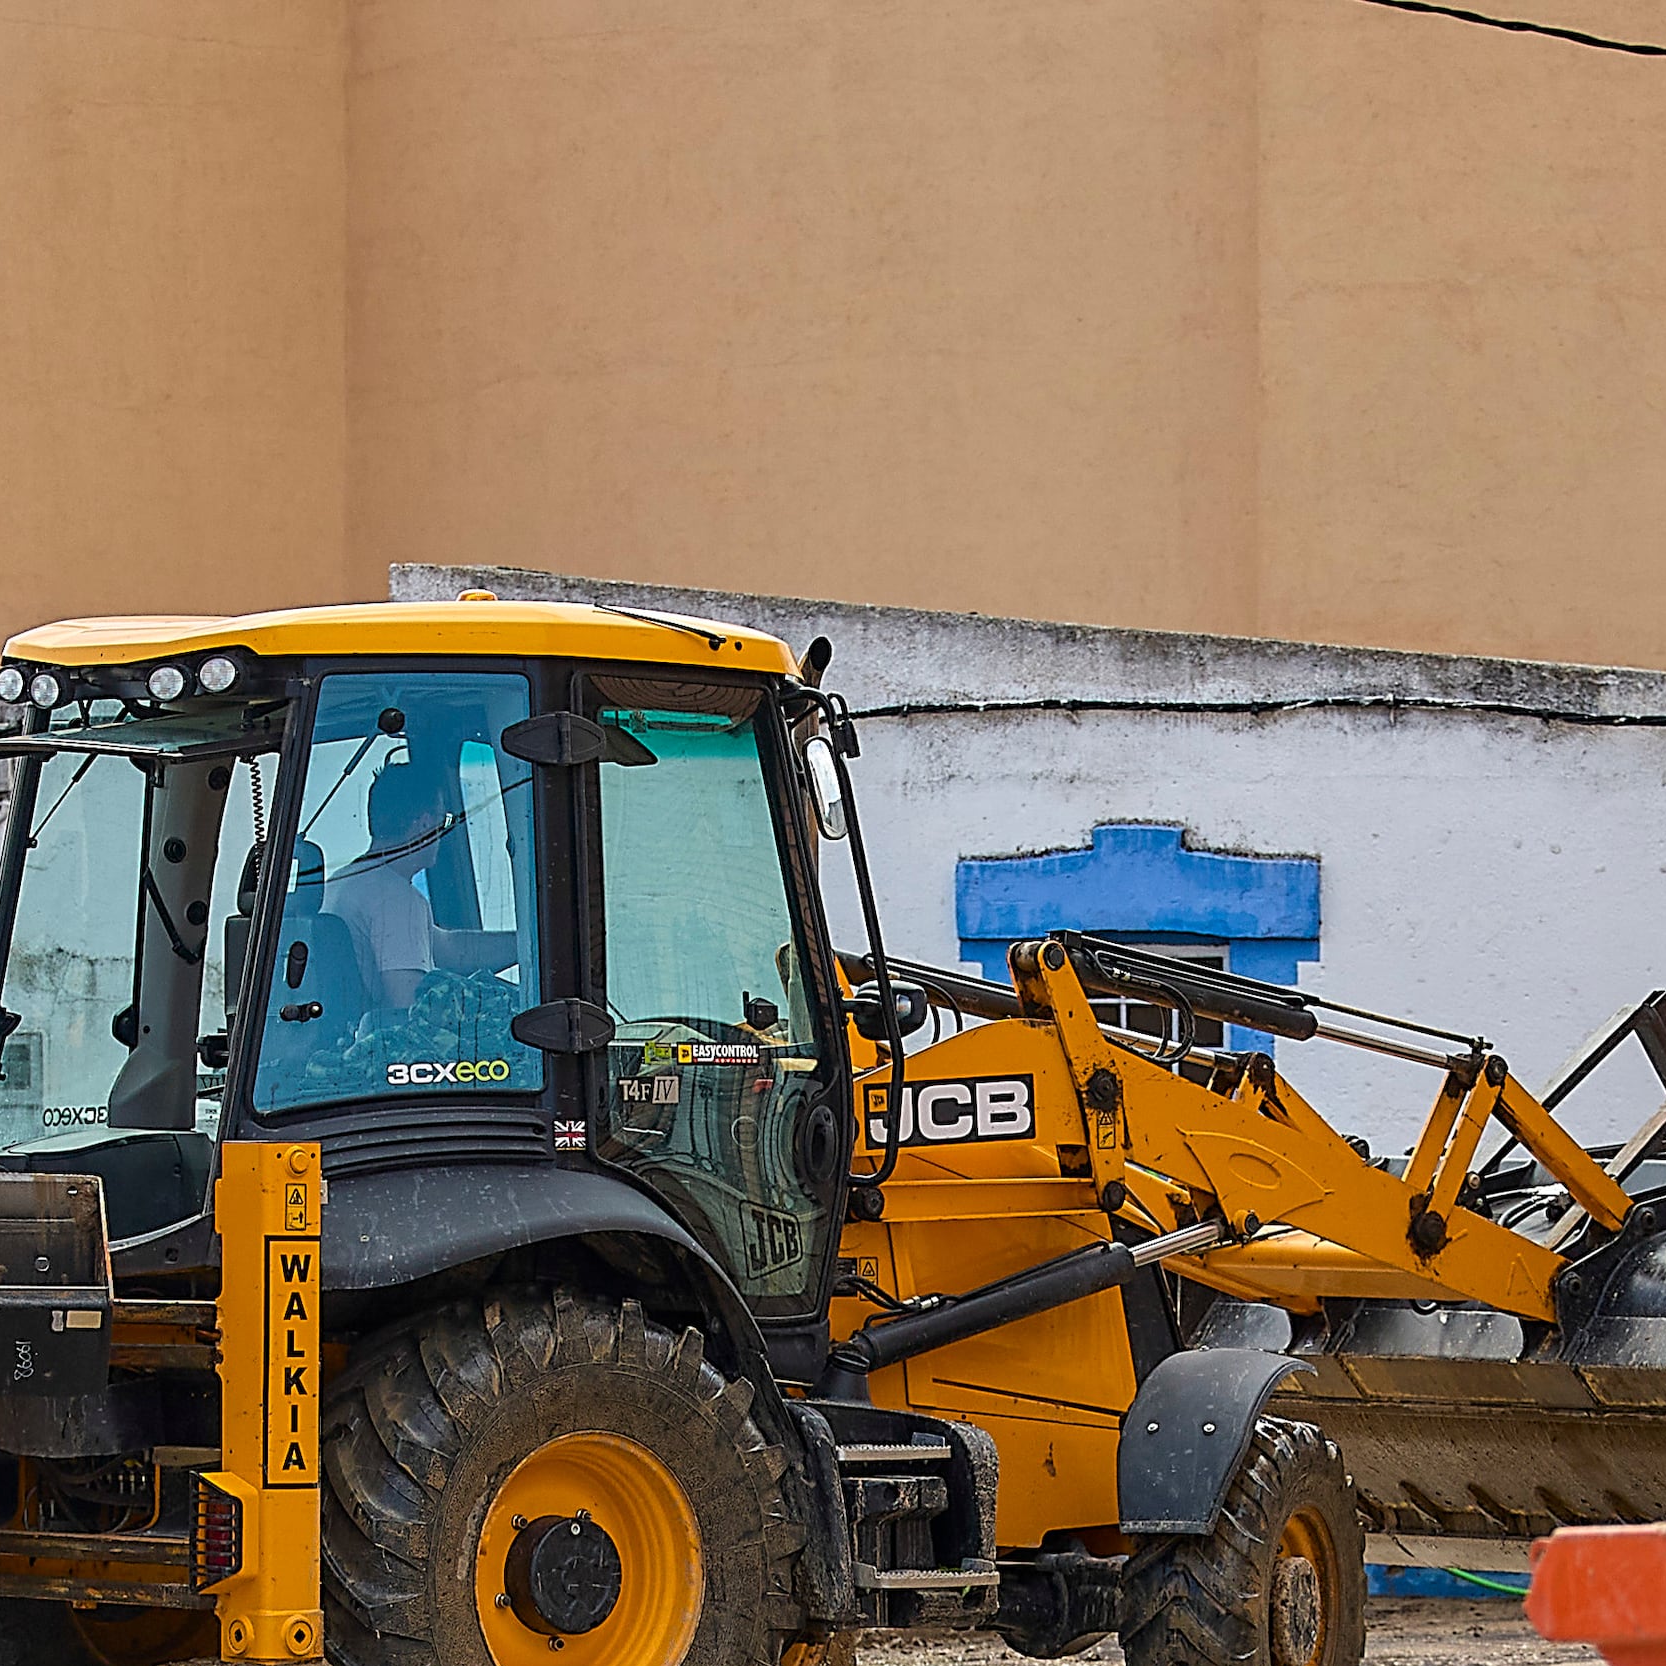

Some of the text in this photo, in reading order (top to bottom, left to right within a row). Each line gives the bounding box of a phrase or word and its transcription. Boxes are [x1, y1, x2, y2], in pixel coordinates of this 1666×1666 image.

[387, 1060, 510, 1085] 3CXeco
[693, 1044, 759, 1060] EASYCONTROL
[869, 1080, 1031, 1143] JCB
[749, 1209, 799, 1272] JCB
[280, 1254, 312, 1471] WALKIA
